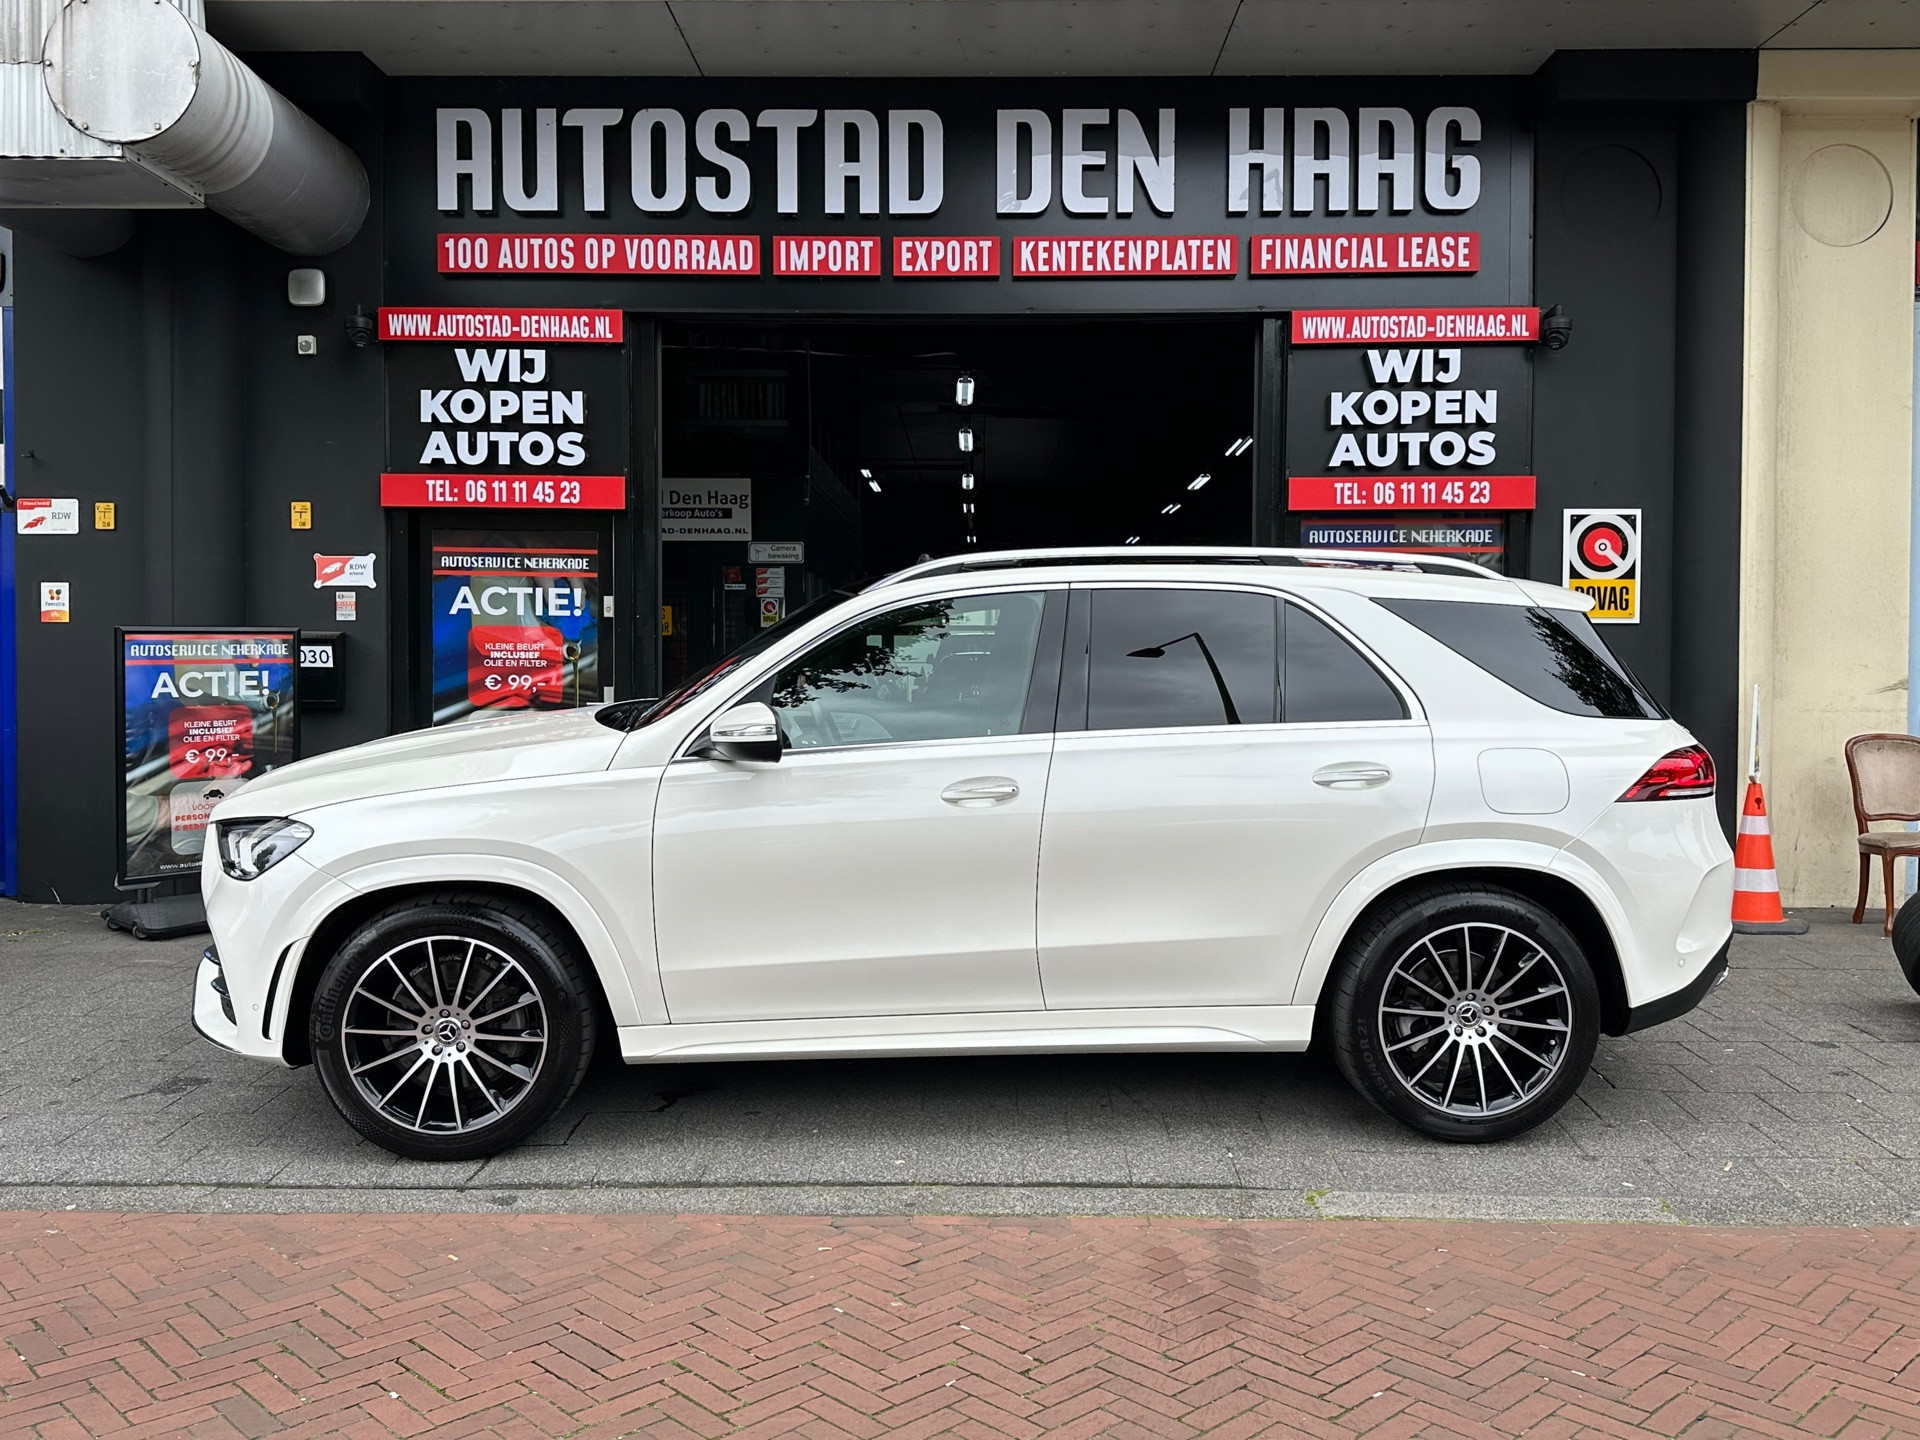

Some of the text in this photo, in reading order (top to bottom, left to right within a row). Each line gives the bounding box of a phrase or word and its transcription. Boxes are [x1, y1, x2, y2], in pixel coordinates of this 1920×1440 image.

[436, 106, 1482, 214] AUTOSTAD DEN HAAG
[444, 238, 754, 271] 100 AUTOS OP VOORRAAD
[779, 239, 874, 272] IMPORT
[900, 239, 993, 272] EXPORT
[1020, 238, 1232, 272] KENTEKENPLATEN
[1260, 236, 1471, 270] FINANCIAL LEASE
[388, 314, 613, 339] WWW.AUTOSTAD-DENHAAG.NL
[1302, 314, 1530, 339] WWW.AUTOSTAD-DENHAAG.NL
[454, 348, 547, 383] WIJ
[1366, 348, 1462, 383] WIJ
[420, 389, 584, 424] KOPEN
[1330, 390, 1498, 426] KOPEN
[419, 431, 586, 466] AUTOS
[1328, 431, 1496, 467] AUTOS
[425, 479, 580, 504] TEL: 06 11 11 45 23
[669, 490, 702, 505] Den
[707, 490, 749, 509] Haag
[1334, 481, 1490, 505] TEL: 06 11 11 45 23
[693, 509, 723, 517] Auto's
[770, 544, 796, 552] Camera
[1309, 529, 1493, 543] AUTOSERVICE NEHERKADE
[441, 556, 589, 570] AUTOSERVICE NEHERKADE
[449, 586, 582, 617] ACTIE!
[130, 644, 289, 657] AUTOSERVICE NEHERKADE
[485, 643, 545, 651] KLEINE BEURT
[490, 651, 540, 659] INCLUSIEF
[483, 659, 547, 668] OLIE EN FILTER
[151, 670, 270, 698] ACTIE!
[484, 674, 546, 693] € 99,-
[184, 719, 237, 728] KLEINE BEURT
[189, 727, 234, 735] INCLUSIEF
[183, 734, 240, 743] OLIE EN FILTER
[185, 748, 240, 764] € 99,-
